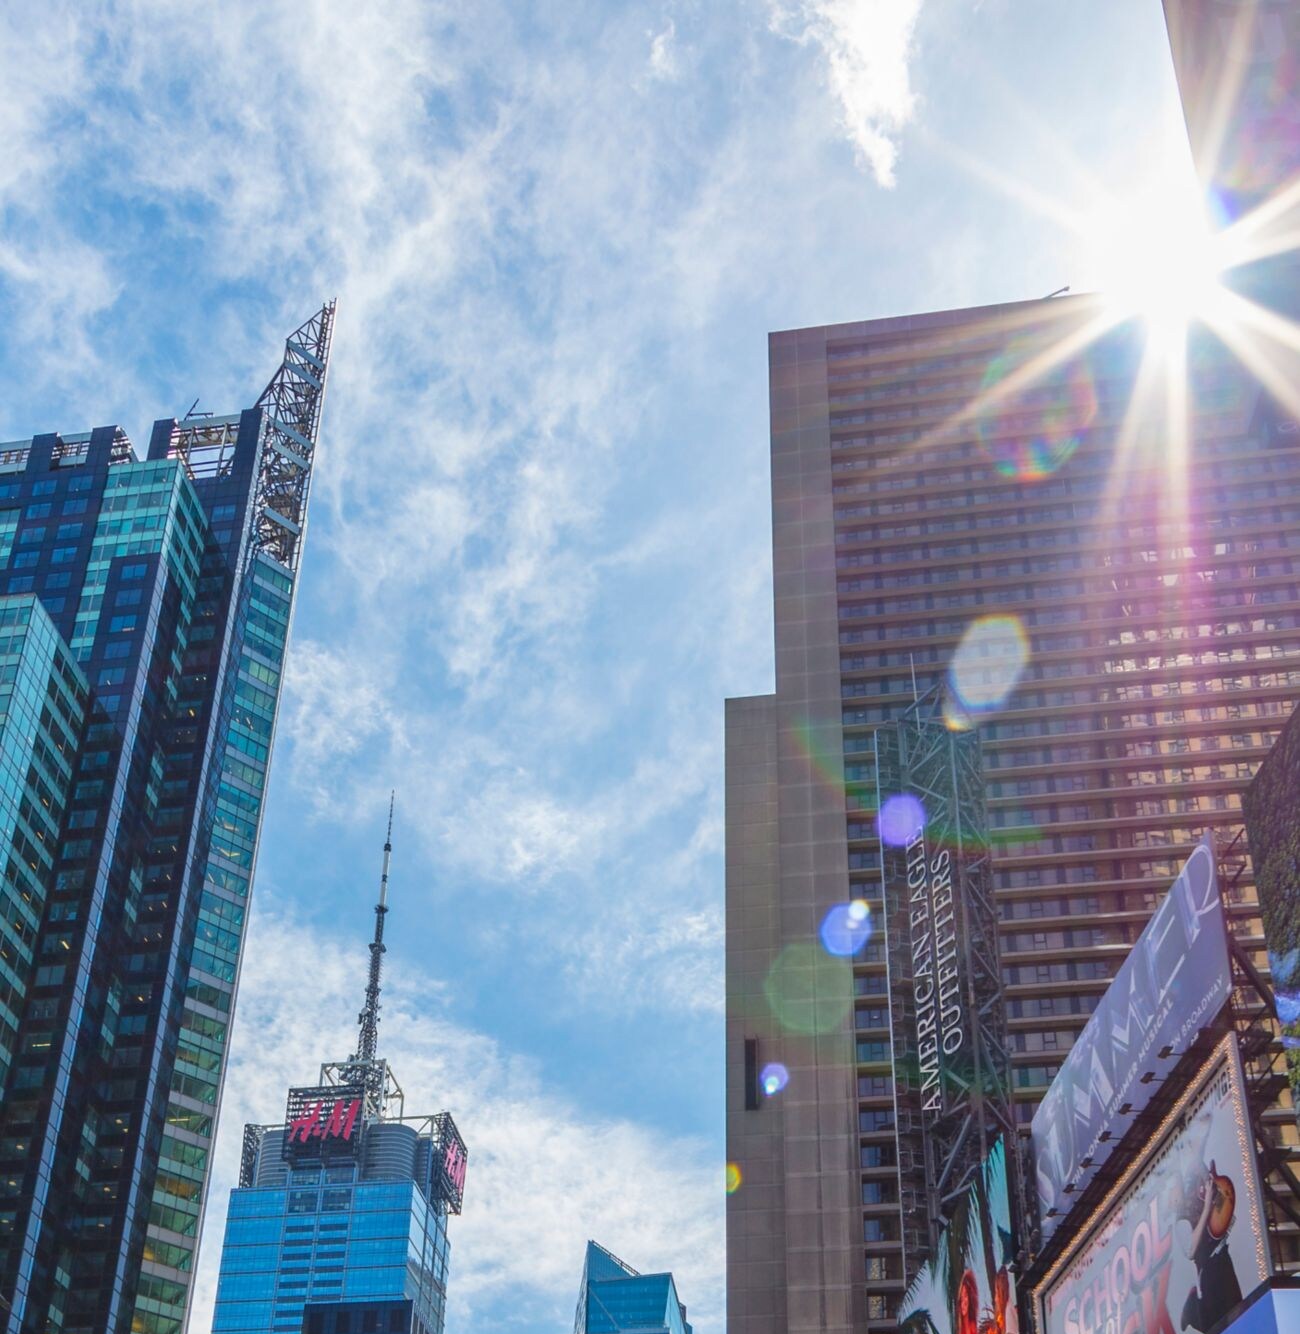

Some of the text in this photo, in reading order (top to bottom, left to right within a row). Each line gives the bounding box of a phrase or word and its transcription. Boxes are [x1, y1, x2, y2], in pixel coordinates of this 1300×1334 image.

[906, 825, 942, 1112] AMERICAN EAGLE
[931, 850, 964, 1055] OUTFITTERS
[1181, 974, 1222, 1037] BROADWAY
[1109, 1063, 1138, 1119] SUMMER
[1139, 998, 1174, 1061] MUSICAL
[288, 1098, 362, 1143] H&M
